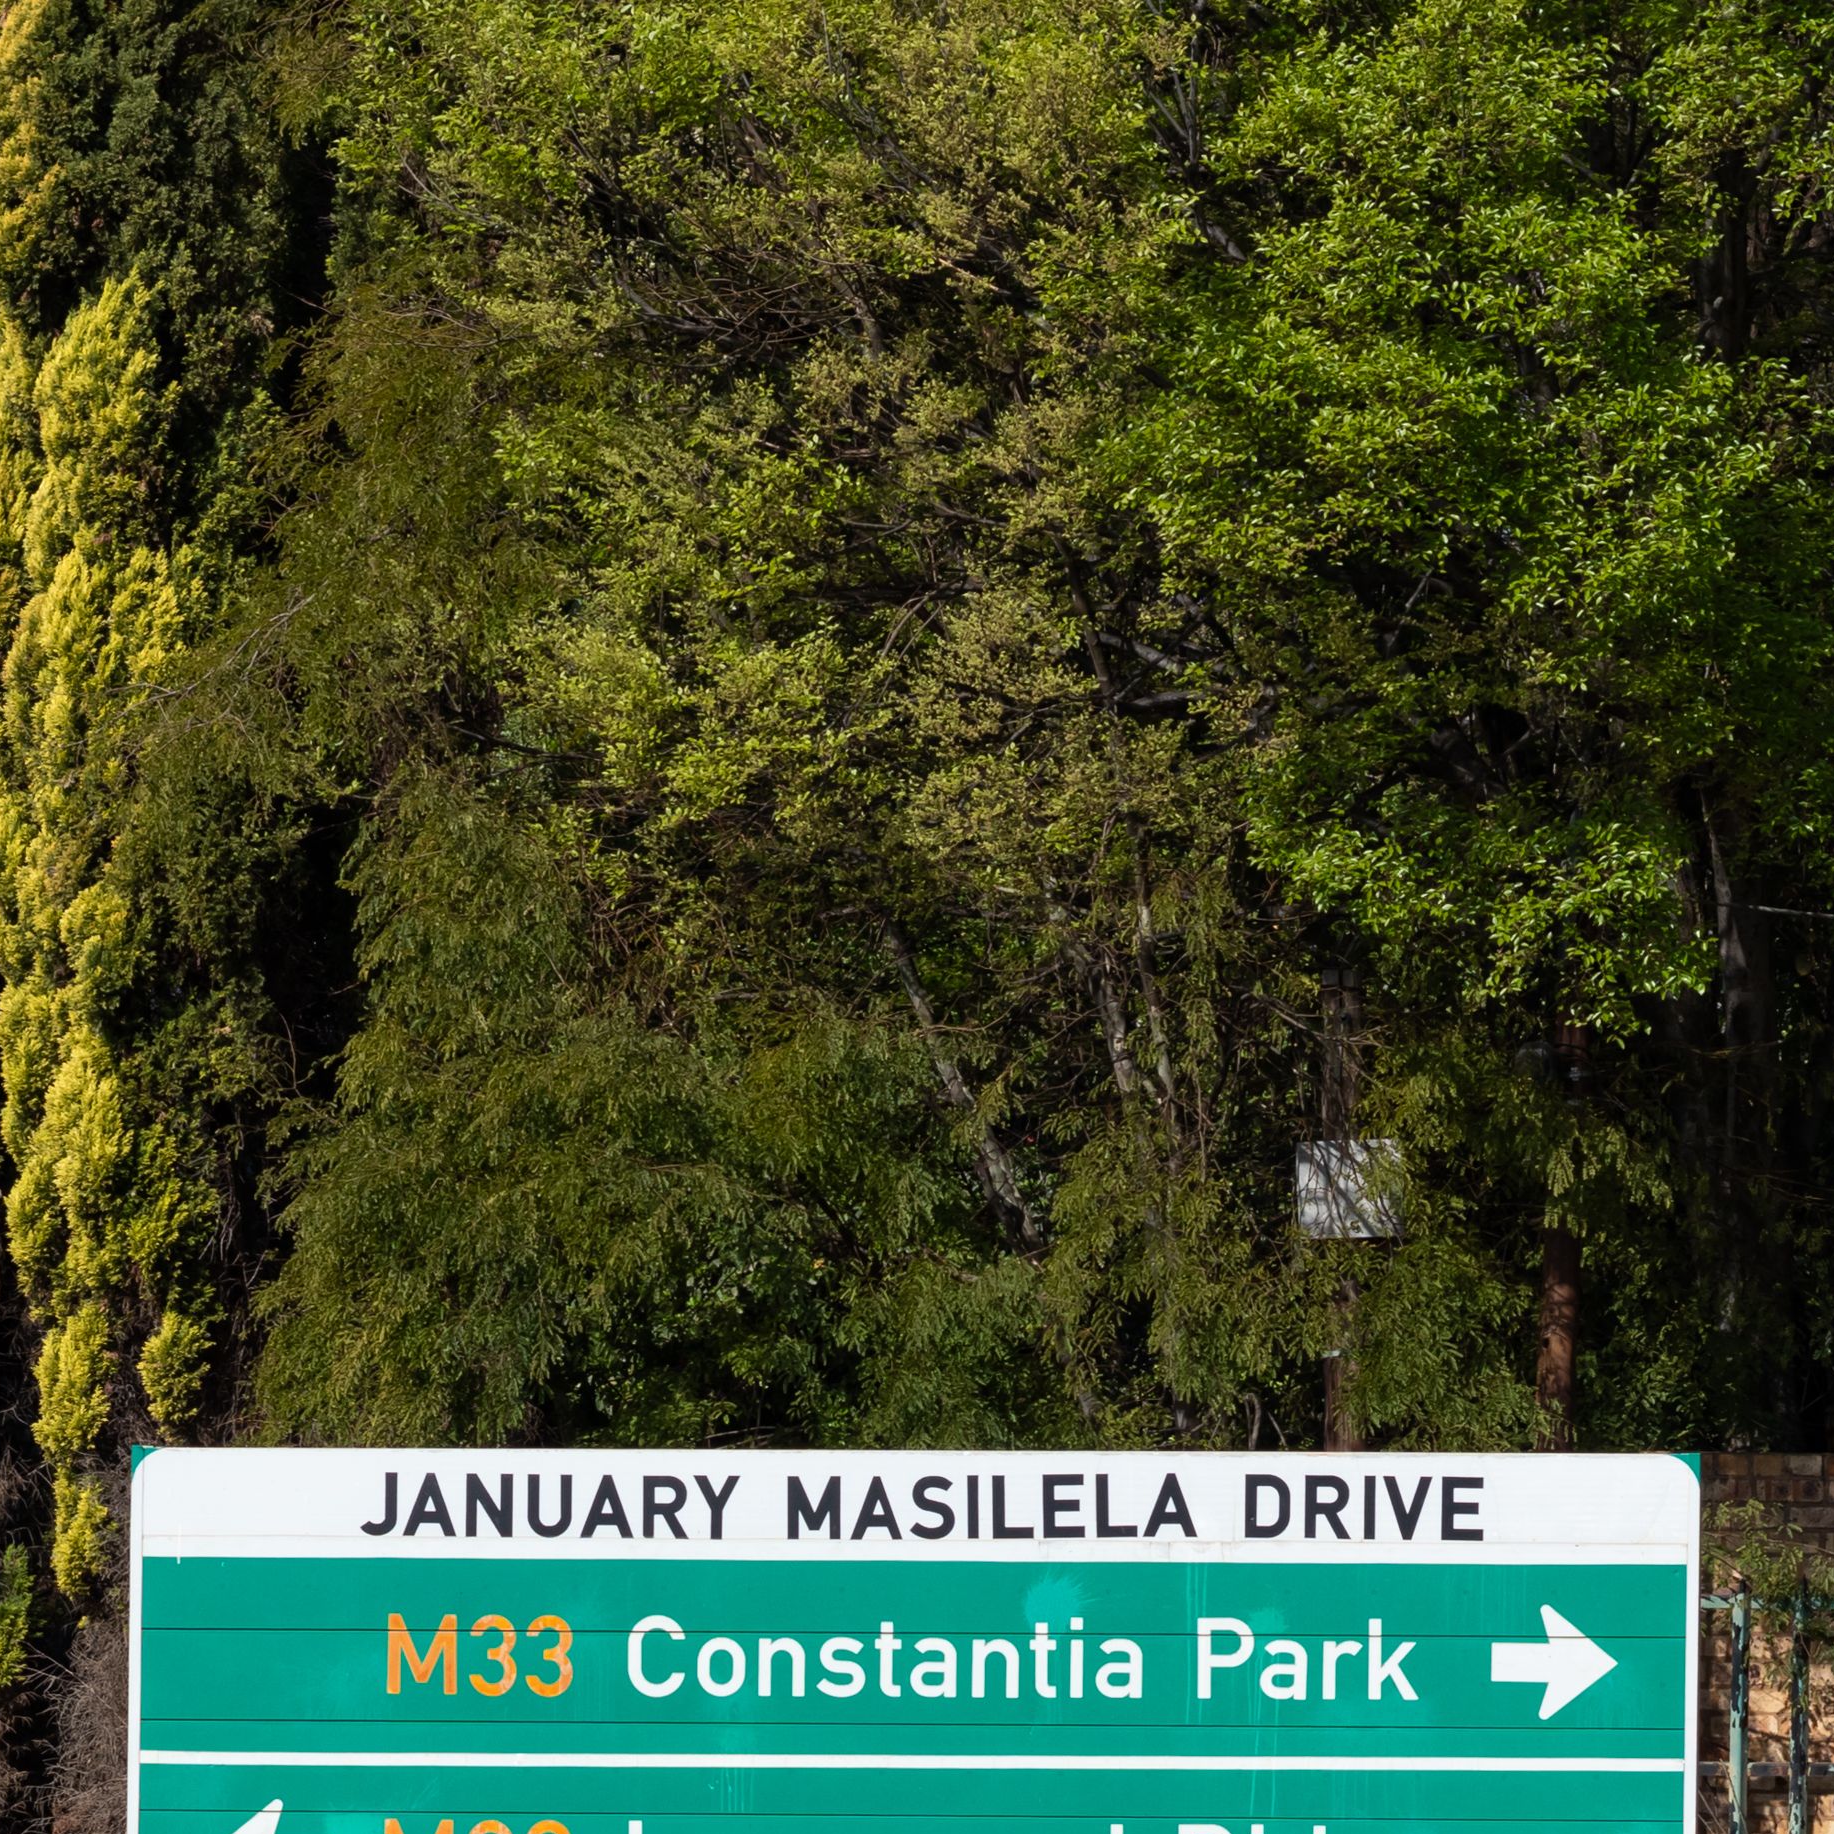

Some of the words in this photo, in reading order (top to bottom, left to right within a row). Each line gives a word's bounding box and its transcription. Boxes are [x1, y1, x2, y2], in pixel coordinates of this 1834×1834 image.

[360, 1472, 740, 1540] JANUARY
[787, 1473, 1198, 1540] MASILELA
[1244, 1474, 1484, 1542] DRIVE
[386, 1613, 574, 1698] M33
[626, 1614, 1144, 1700] Constantia
[1196, 1616, 1420, 1702] Park
